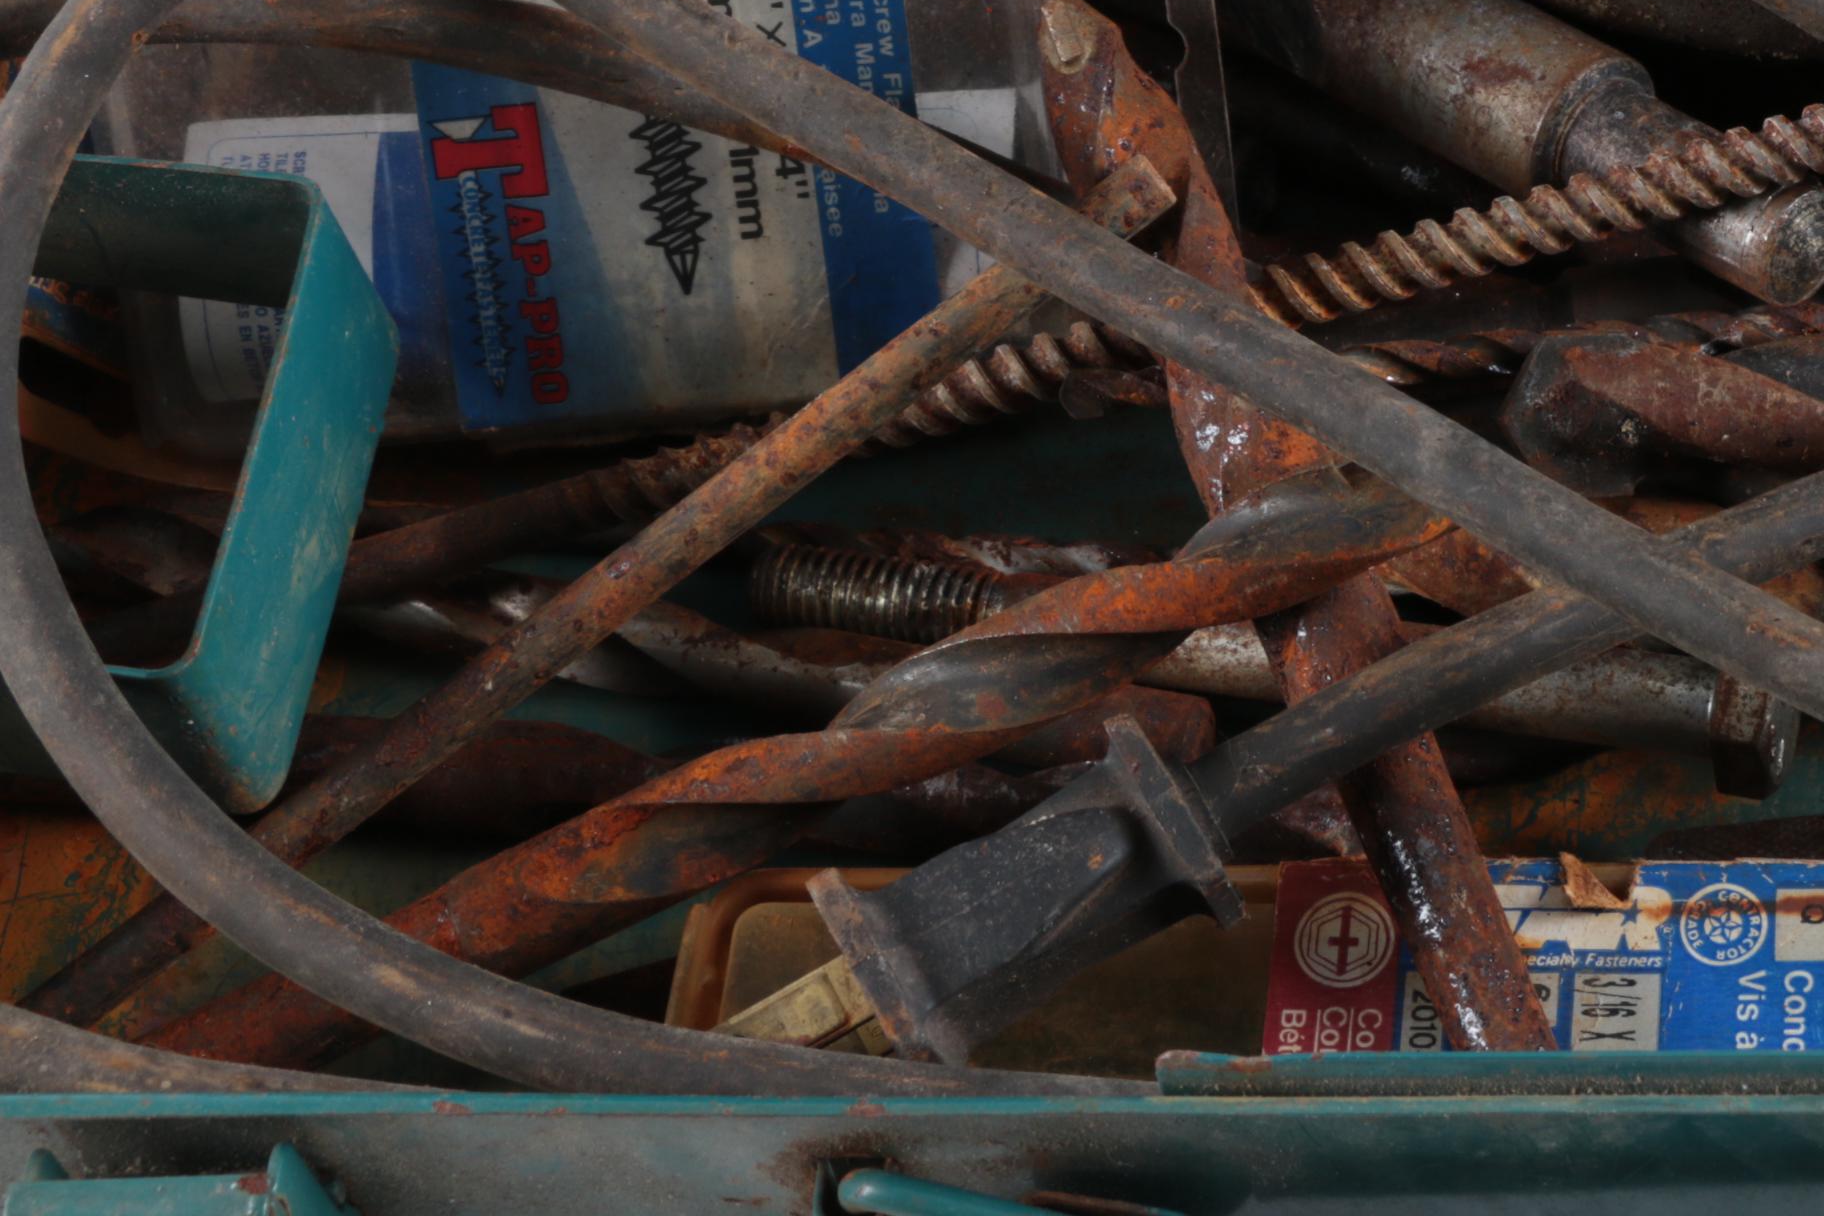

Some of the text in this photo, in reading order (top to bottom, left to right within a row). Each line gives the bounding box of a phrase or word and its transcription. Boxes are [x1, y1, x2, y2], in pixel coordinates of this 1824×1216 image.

[802, 28, 823, 48] A
[430, 102, 570, 405] TAP-PRO
[1585, 953, 1663, 968] Fasteners
[1574, 977, 1643, 1018] 3/16
[1737, 969, 1767, 1021] Vis
